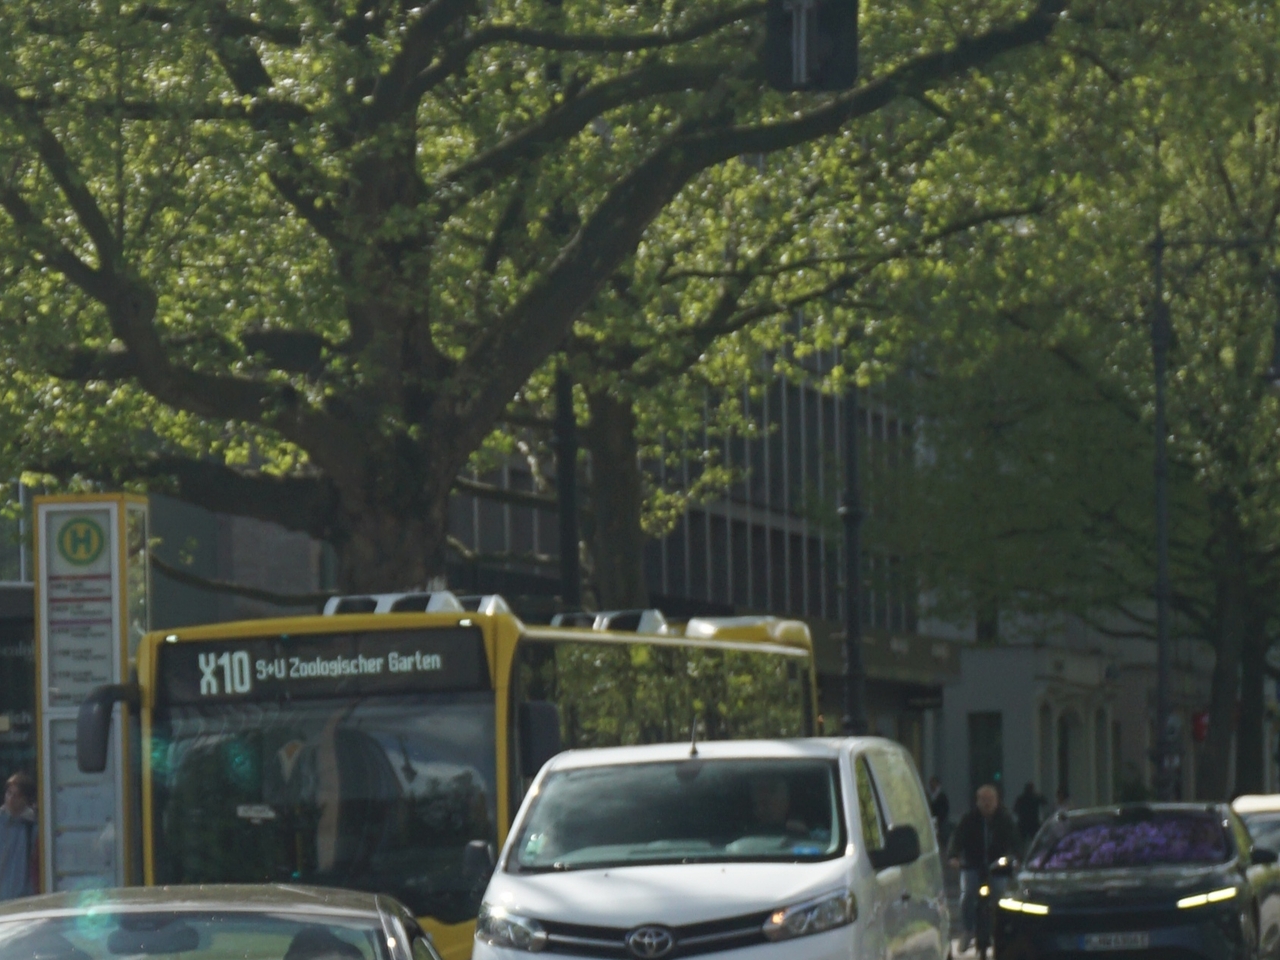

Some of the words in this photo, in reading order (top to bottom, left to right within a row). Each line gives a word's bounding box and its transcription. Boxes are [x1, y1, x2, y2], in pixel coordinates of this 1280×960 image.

[70, 528, 93, 554] H
[198, 651, 252, 695] X10
[255, 659, 286, 680] S+U
[289, 653, 384, 678] Zoologischer
[387, 650, 442, 672] Garten
